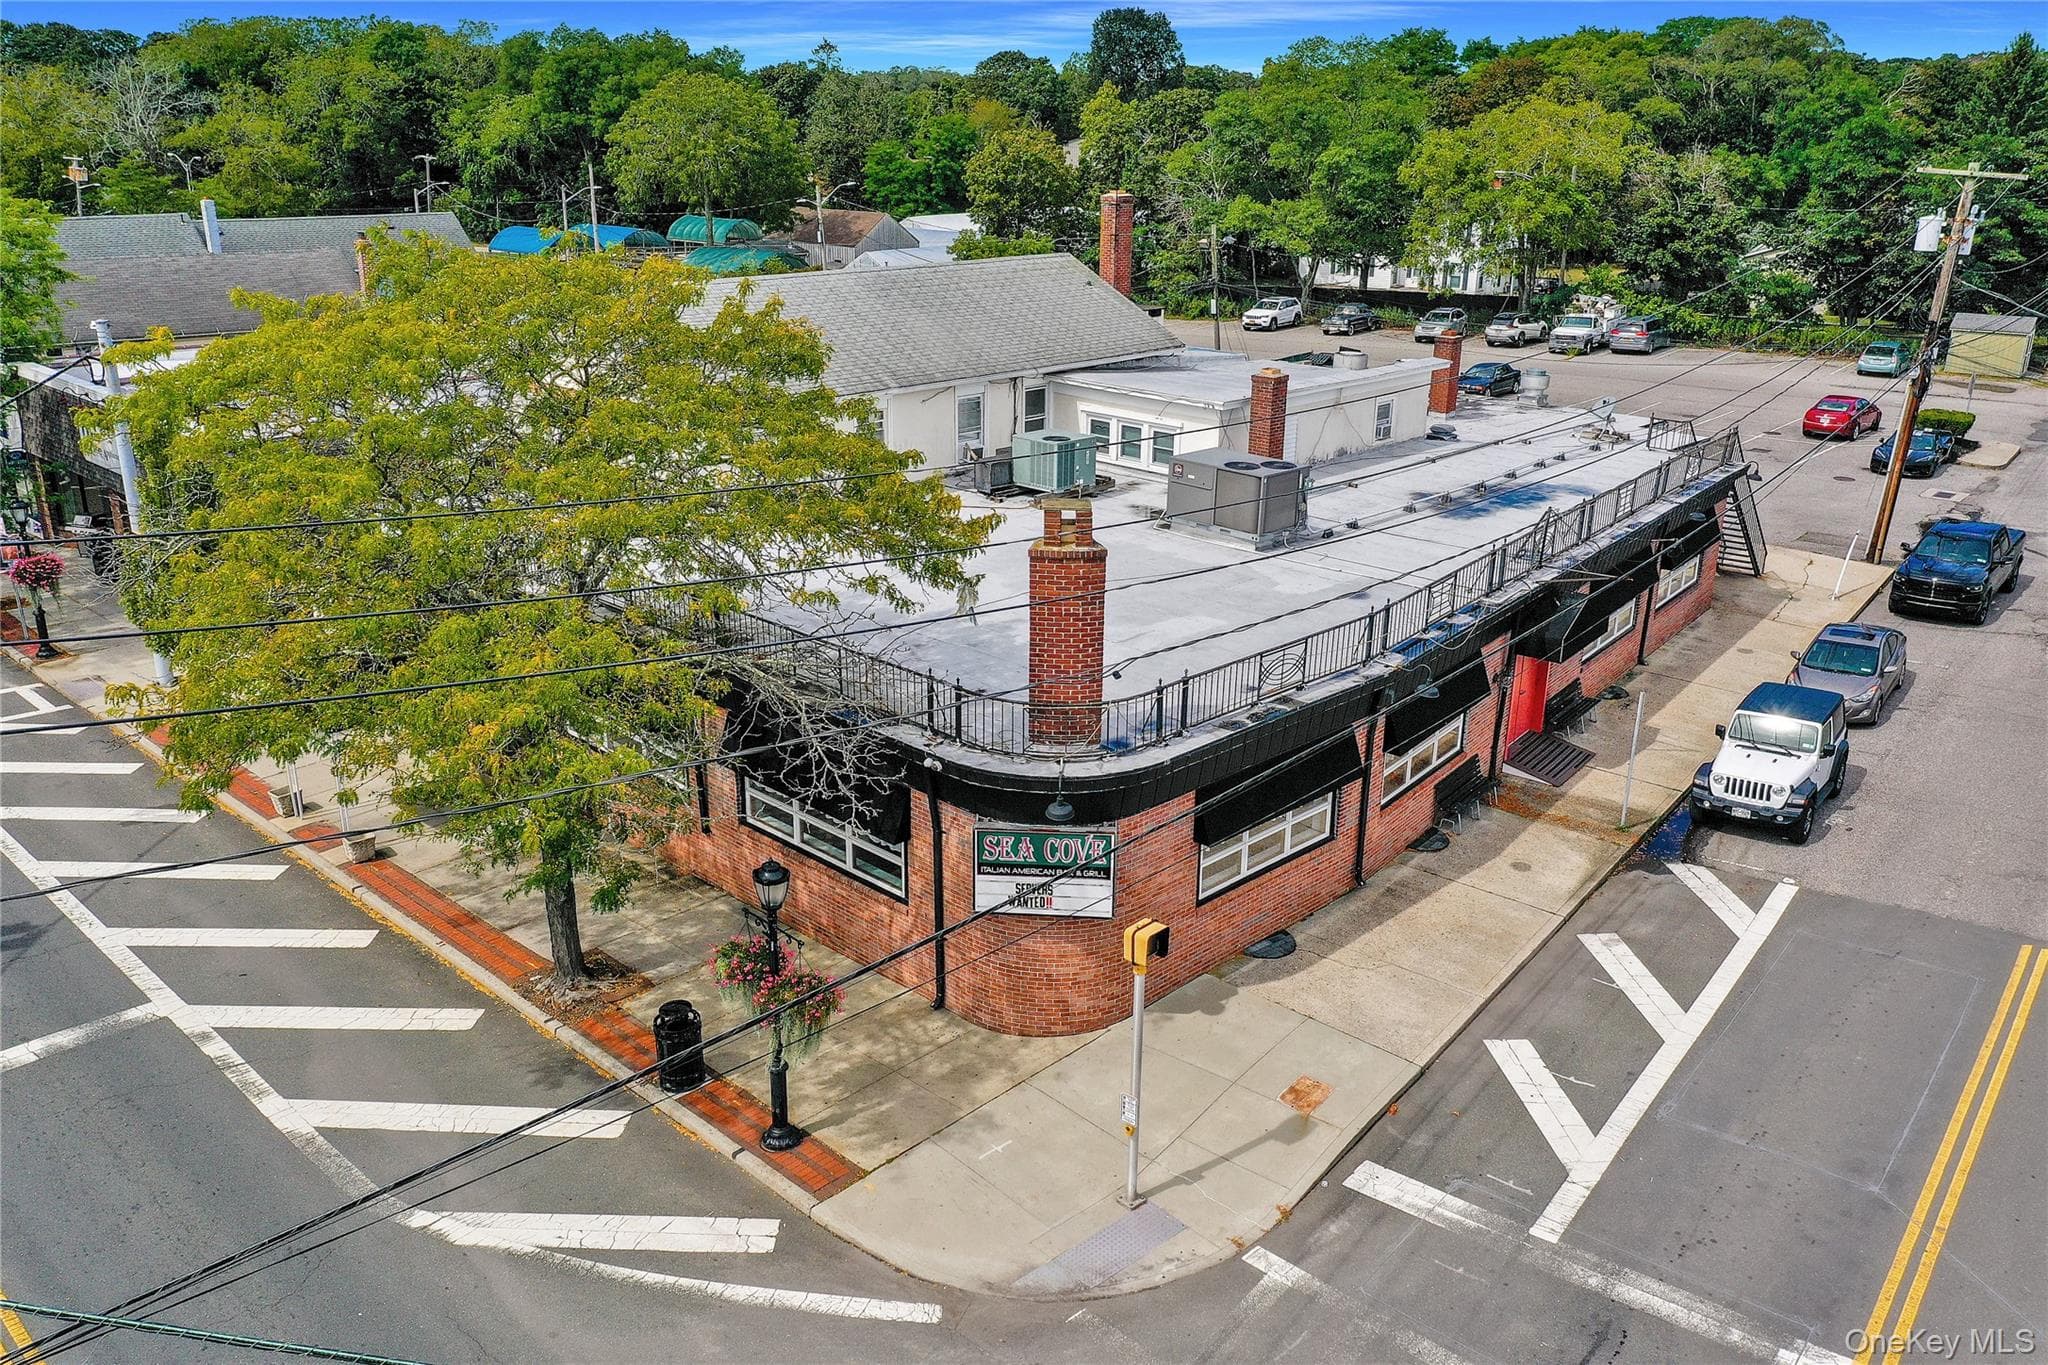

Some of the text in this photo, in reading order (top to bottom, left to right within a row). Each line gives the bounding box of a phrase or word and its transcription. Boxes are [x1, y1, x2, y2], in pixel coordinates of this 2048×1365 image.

[983, 834, 1107, 865] SEA COVE
[980, 866, 1011, 874] ITALIAN
[1011, 867, 1055, 875] AMERICAN
